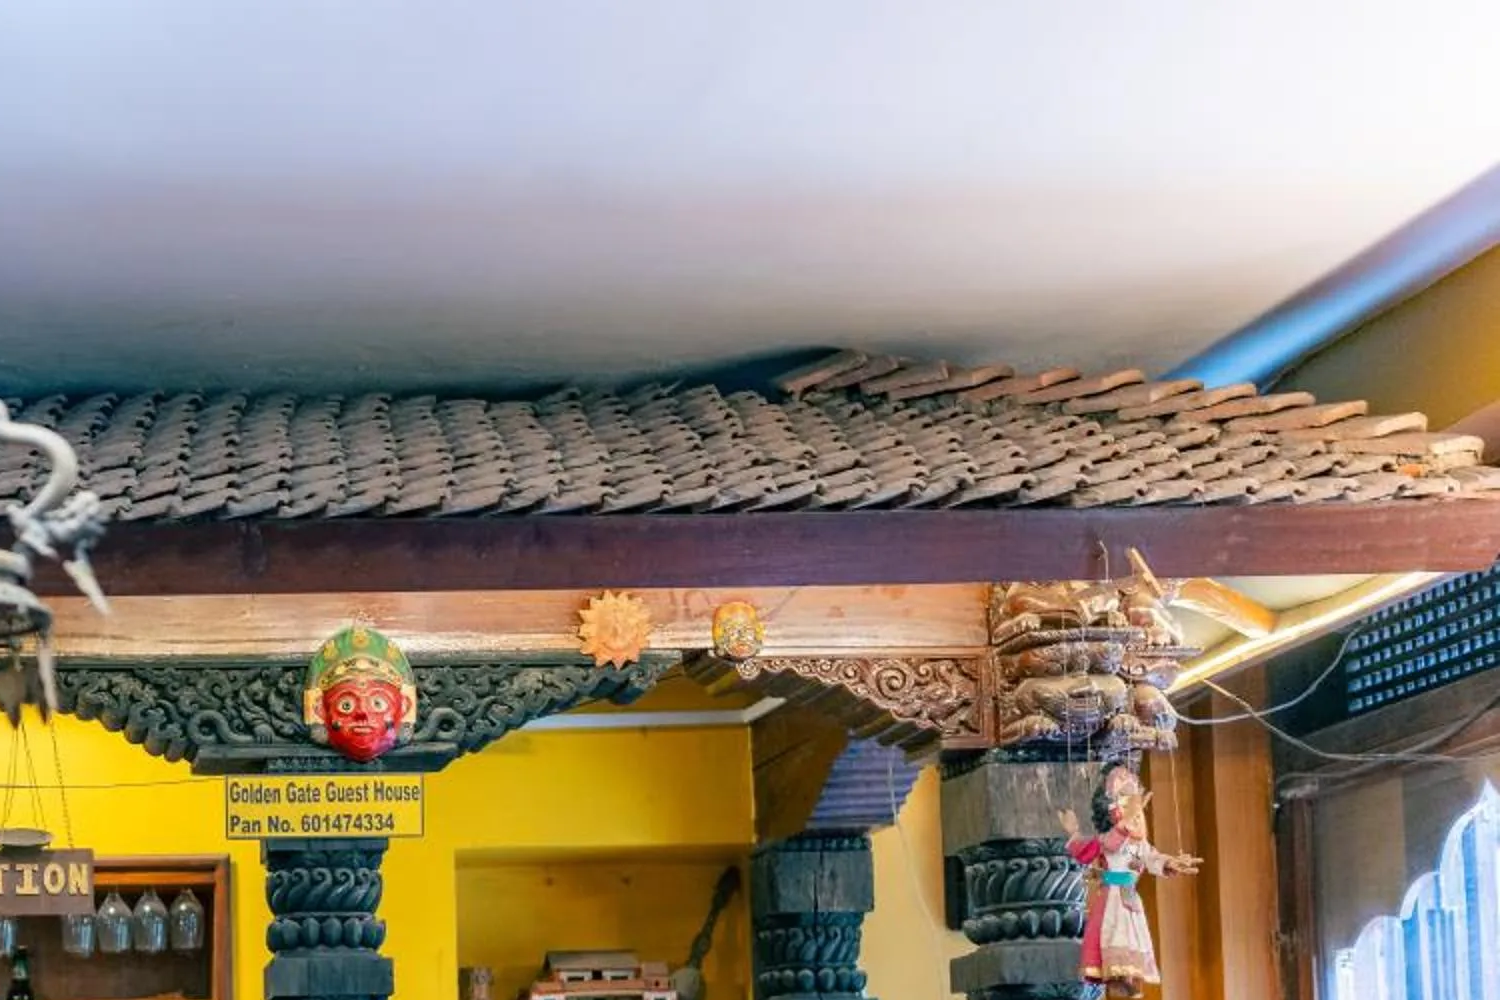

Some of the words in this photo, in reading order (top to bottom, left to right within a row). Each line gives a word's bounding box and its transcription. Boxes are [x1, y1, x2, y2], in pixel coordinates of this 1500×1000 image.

[229, 781, 281, 804] Golden
[285, 781, 321, 803] Gate
[325, 781, 369, 802] Guest
[373, 780, 421, 801] House
[229, 815, 262, 833] Pan
[267, 815, 295, 832] No.
[301, 813, 395, 832] 601474334
